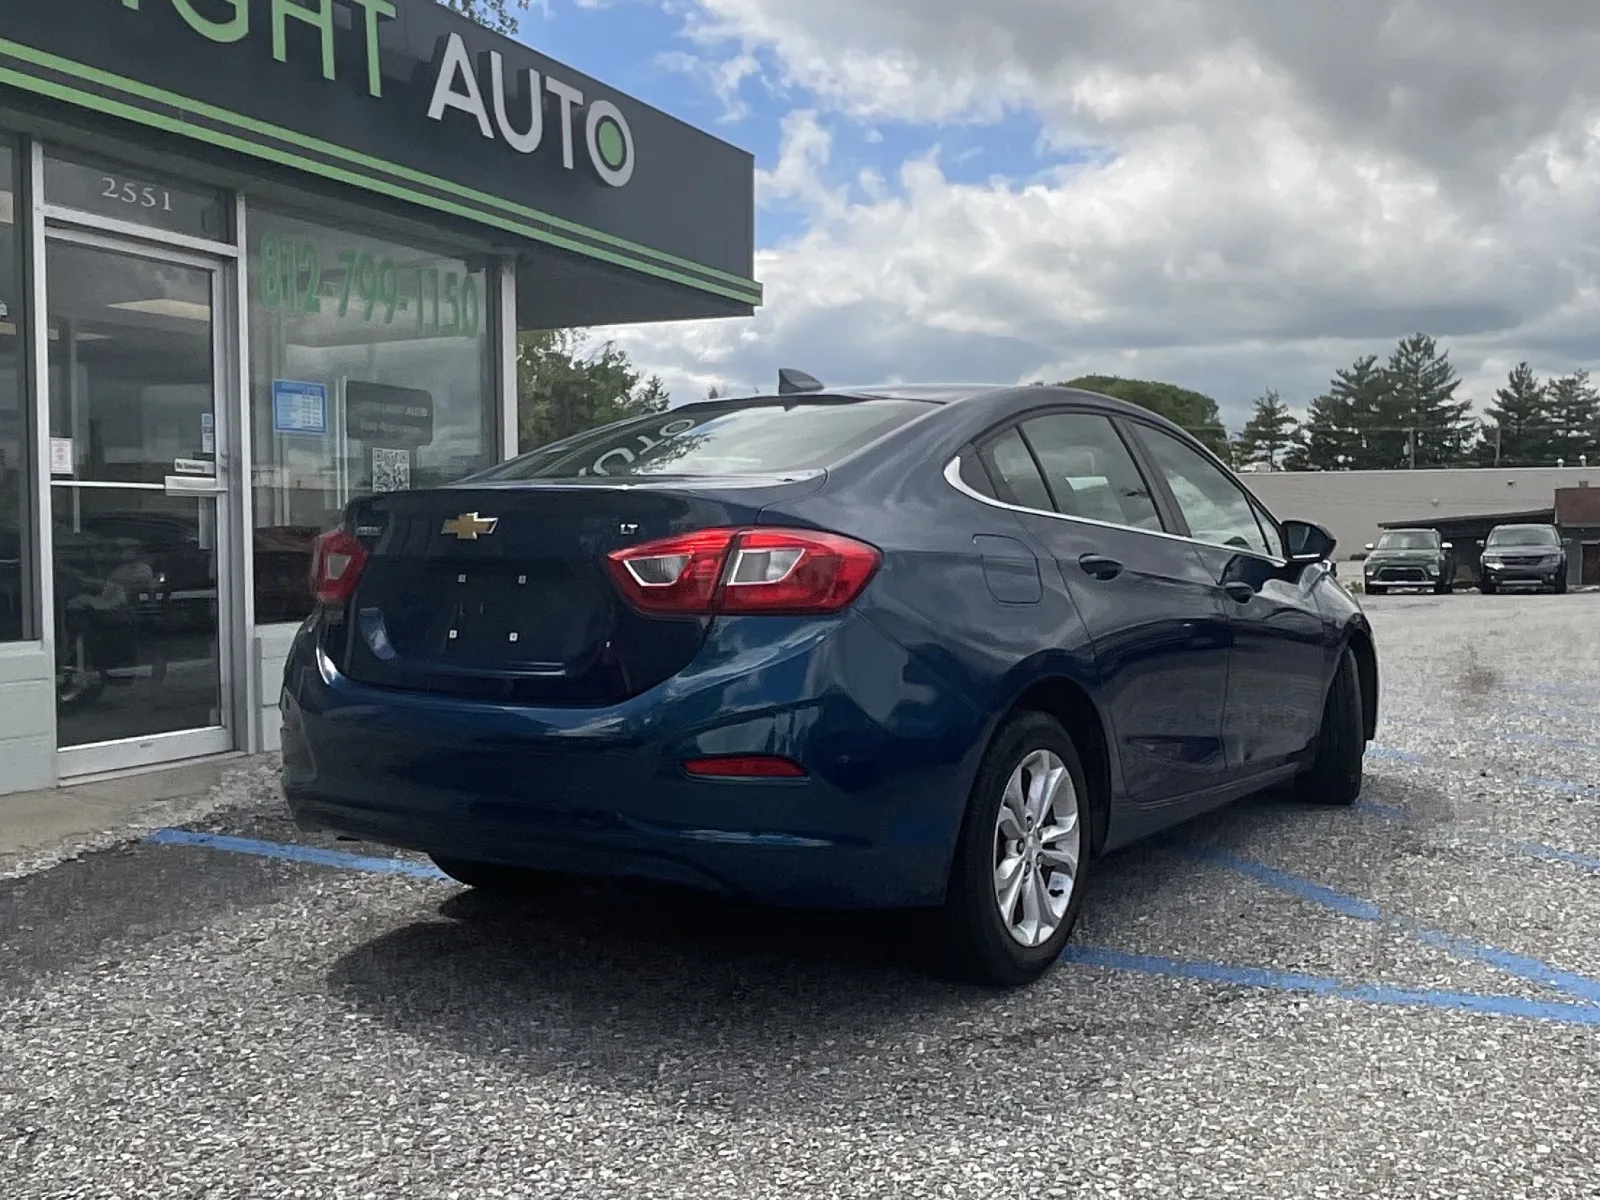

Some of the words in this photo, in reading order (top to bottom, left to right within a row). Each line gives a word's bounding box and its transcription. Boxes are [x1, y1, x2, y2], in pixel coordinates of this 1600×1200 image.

[427, 32, 635, 187] AUTO
[101, 177, 172, 211] 2551
[260, 231, 478, 339] 812-799-1150
[620, 523, 638, 535] LT
